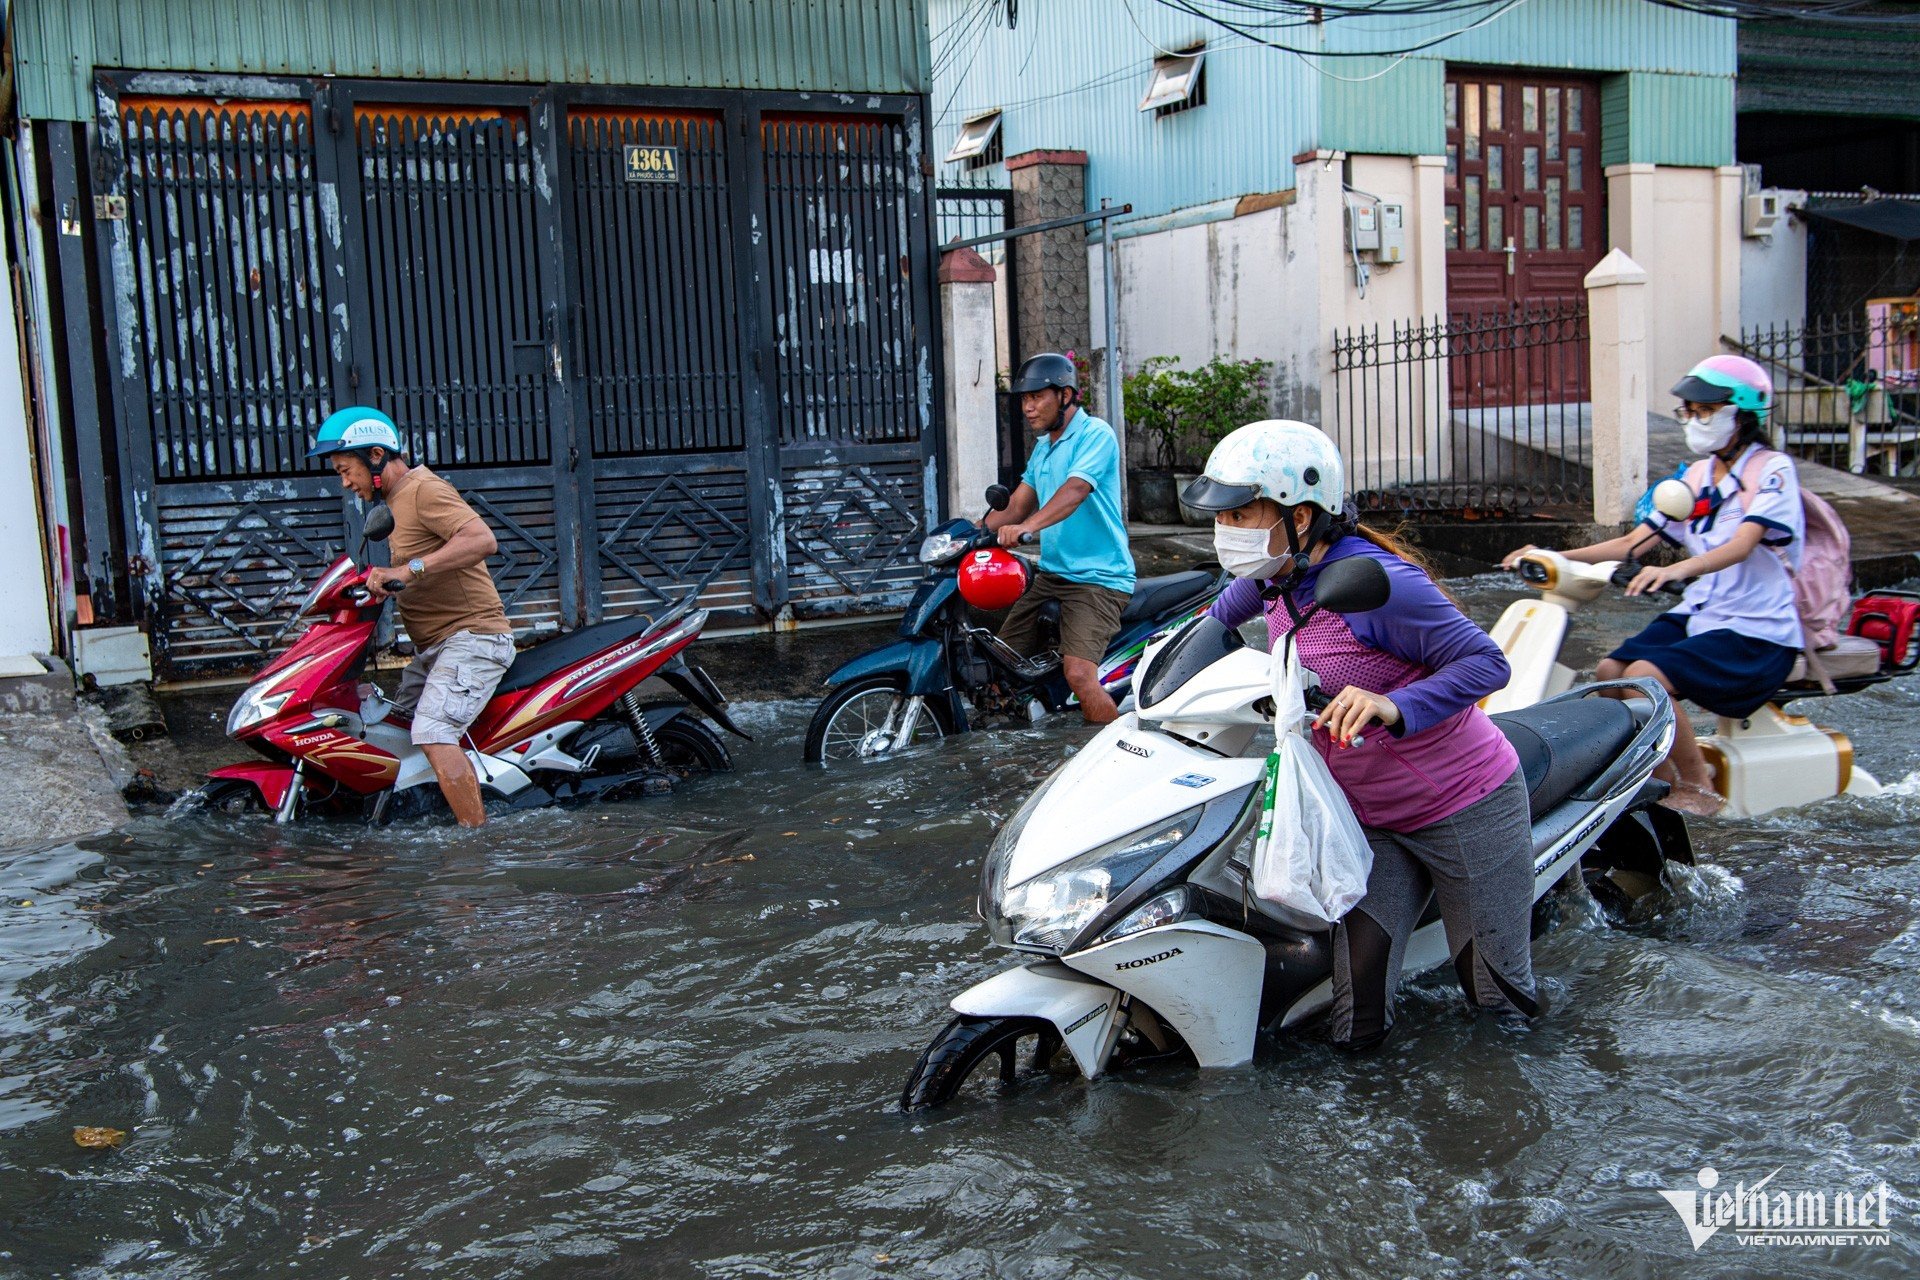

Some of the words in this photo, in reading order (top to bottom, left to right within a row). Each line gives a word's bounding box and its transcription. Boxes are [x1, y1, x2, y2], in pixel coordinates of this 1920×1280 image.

[629, 149, 674, 171] 436A
[294, 732, 336, 747] HONDA
[1115, 947, 1184, 971] HONDA
